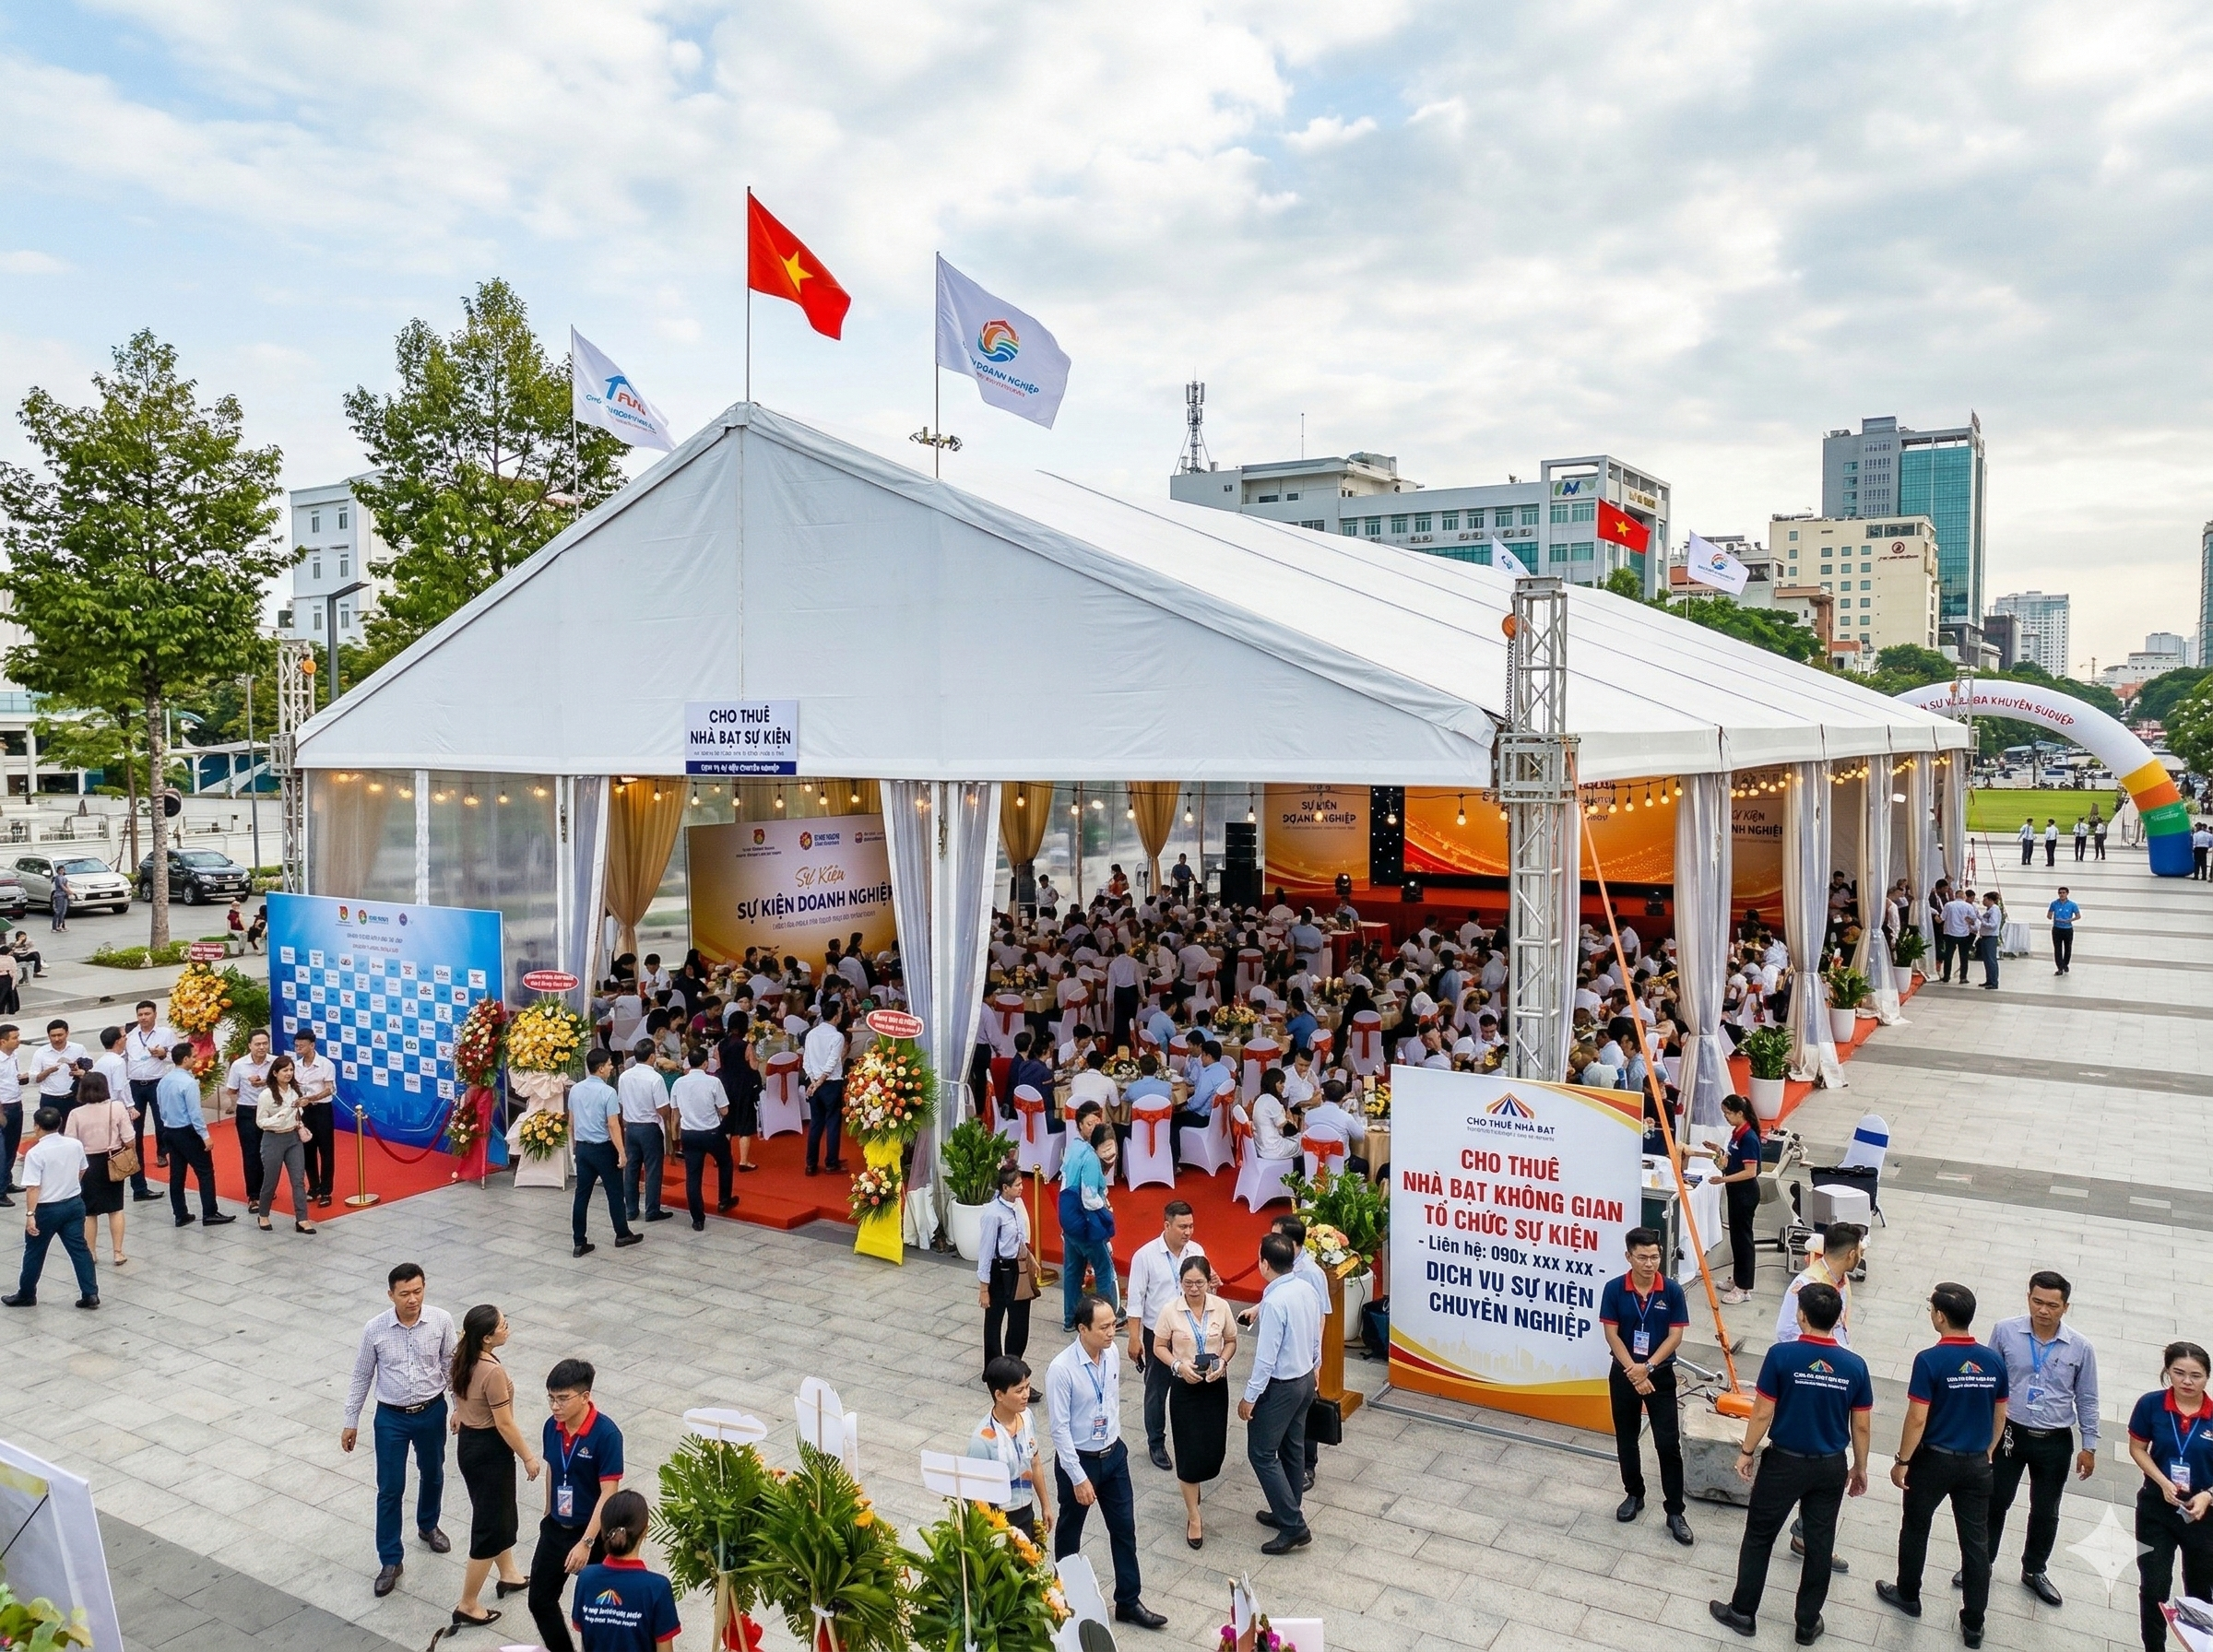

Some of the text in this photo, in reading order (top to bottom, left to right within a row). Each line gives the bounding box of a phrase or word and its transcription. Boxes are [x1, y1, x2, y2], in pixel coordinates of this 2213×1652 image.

[709, 704, 770, 723] CHO THUÊ
[690, 726, 791, 749] NHÀ BẠT SỰ KIỆN
[737, 898, 758, 925] SỰ
[762, 892, 794, 920] KIỆN
[798, 891, 846, 913] DOANH
[1466, 1116, 1486, 1127] CHO
[1461, 1149, 1559, 1182] CHO THUÊ
[1403, 1170, 1623, 1222] NHÀ BẠT KHÔNG GIAN
[1424, 1199, 1598, 1253] TỔ CHỨC SỰ KIỆN
[1429, 1234, 1459, 1254] Liên
[1464, 1241, 1486, 1261] hệ:
[1491, 1245, 1528, 1266] 090x
[1426, 1260, 1593, 1310] DỊCH VỤ SỰ KIỆN
[1429, 1292, 1592, 1341] CHUYÊN NGHIỆP
